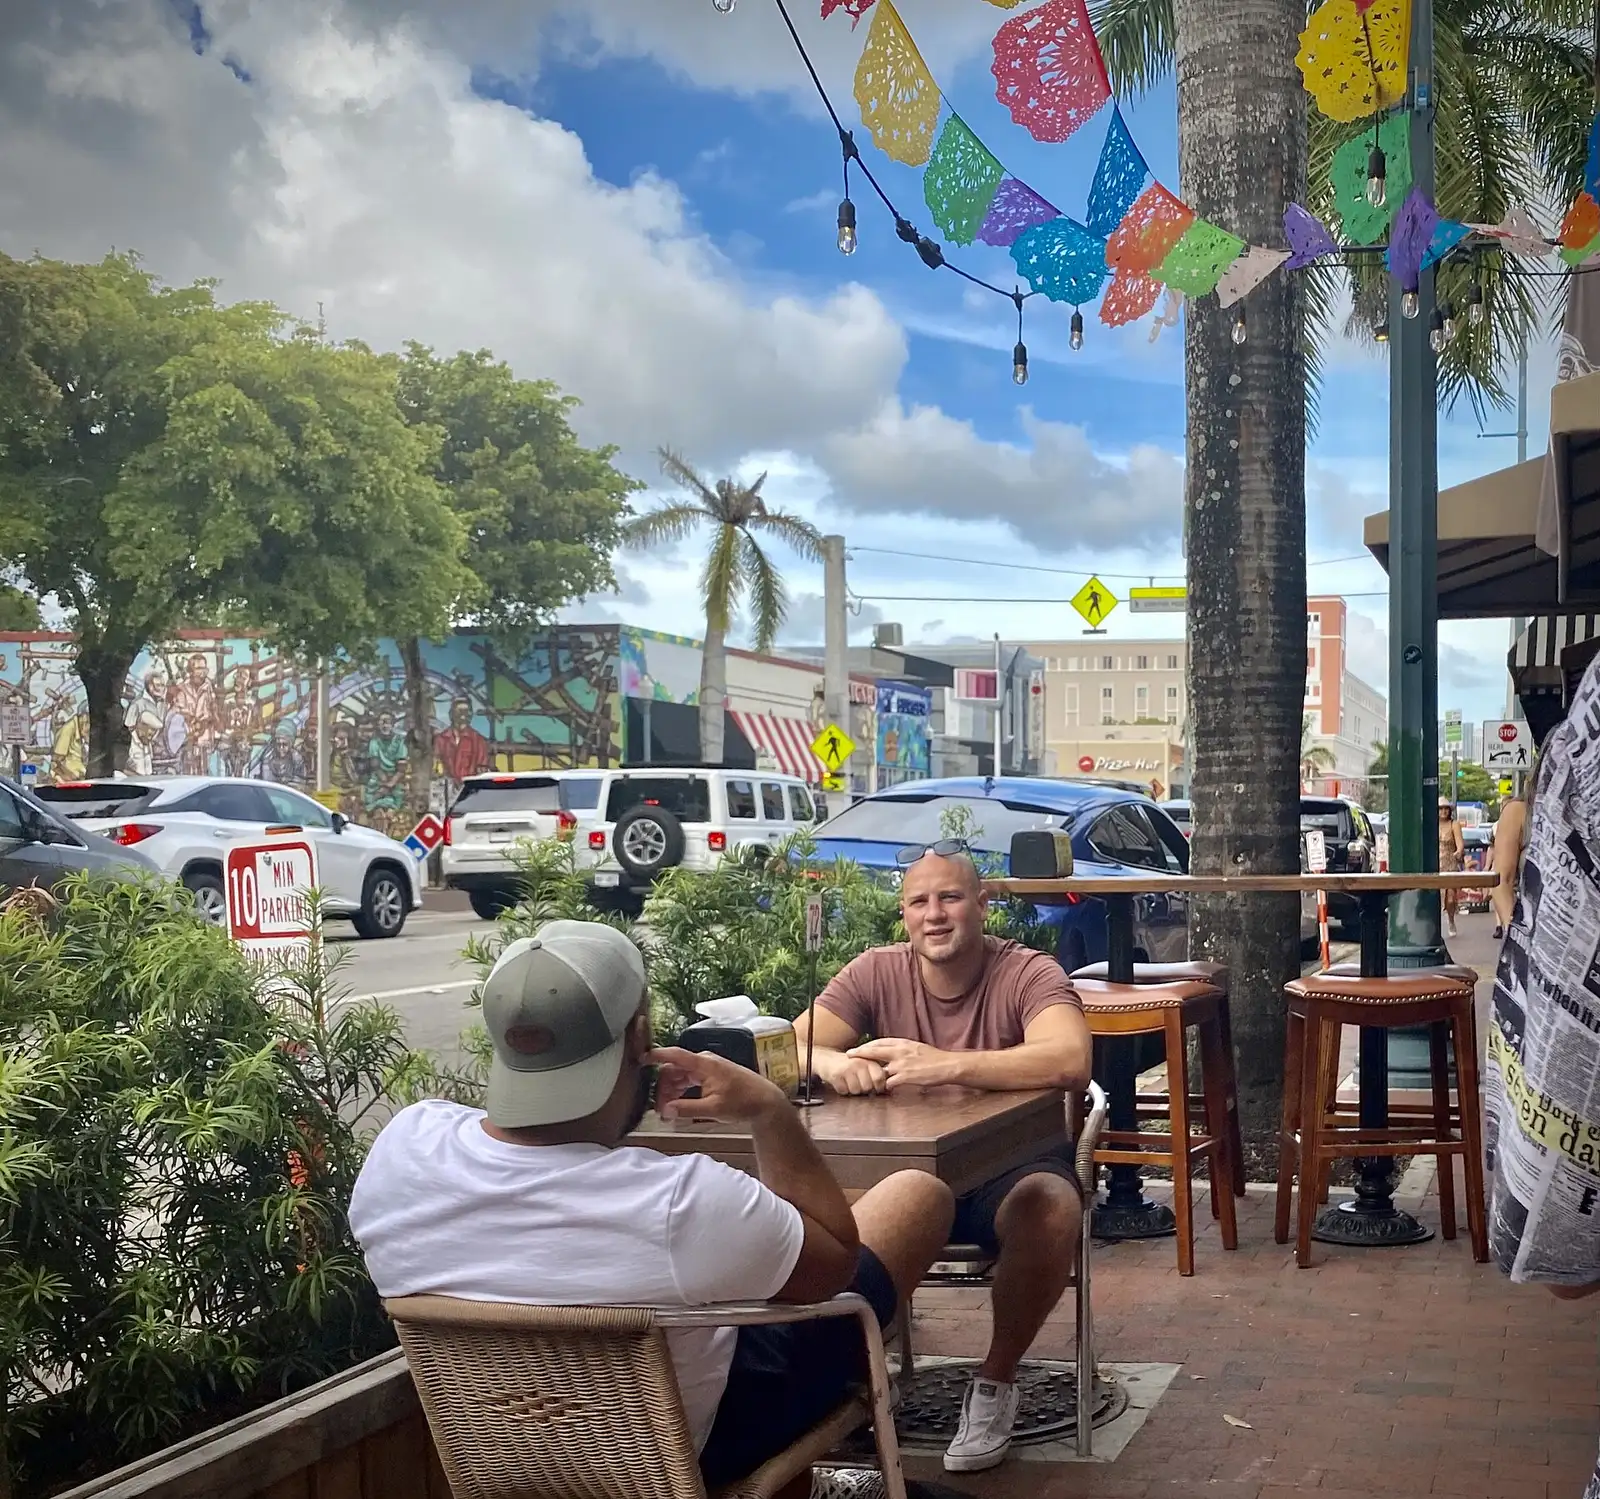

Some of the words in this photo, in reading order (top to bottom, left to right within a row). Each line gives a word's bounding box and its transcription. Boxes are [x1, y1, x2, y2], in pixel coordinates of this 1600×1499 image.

[1499, 728, 1516, 737] STOP
[1094, 757, 1131, 772] Pizza
[1134, 758, 1164, 771] Hut
[273, 861, 295, 888] MIN
[231, 866, 258, 927] 10
